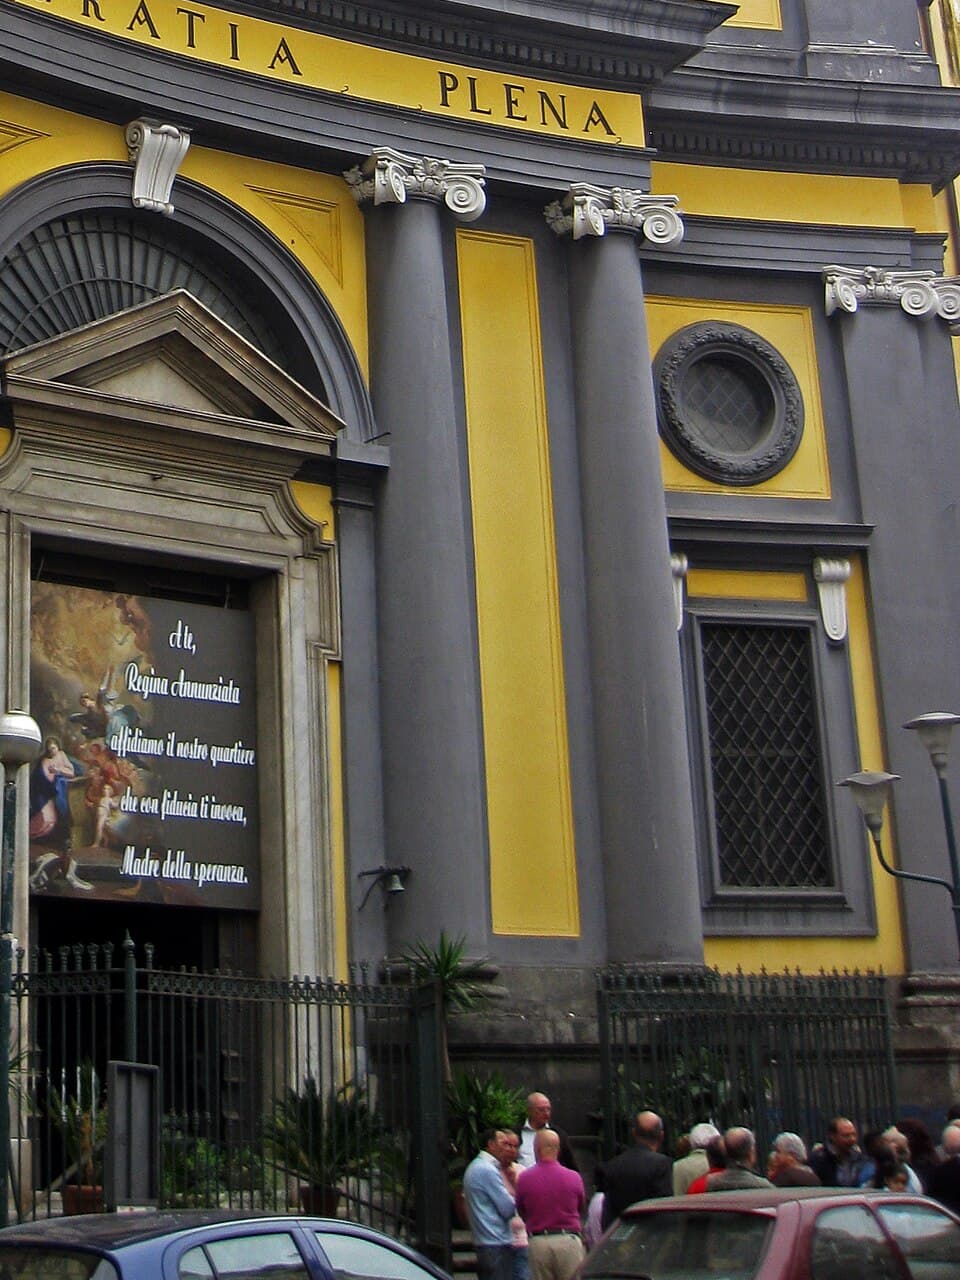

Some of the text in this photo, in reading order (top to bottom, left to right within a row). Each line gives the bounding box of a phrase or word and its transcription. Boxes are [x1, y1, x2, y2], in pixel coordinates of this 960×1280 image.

[438, 71, 616, 136] PLENA
[183, 625, 197, 656] te,
[125, 662, 240, 704] Regina Annunziata
[110, 726, 256, 767] affidiamo il nostro quartiere
[120, 786, 247, 826] che con fiducia ti invoca,
[120, 846, 249, 887] Madre della speranza.
